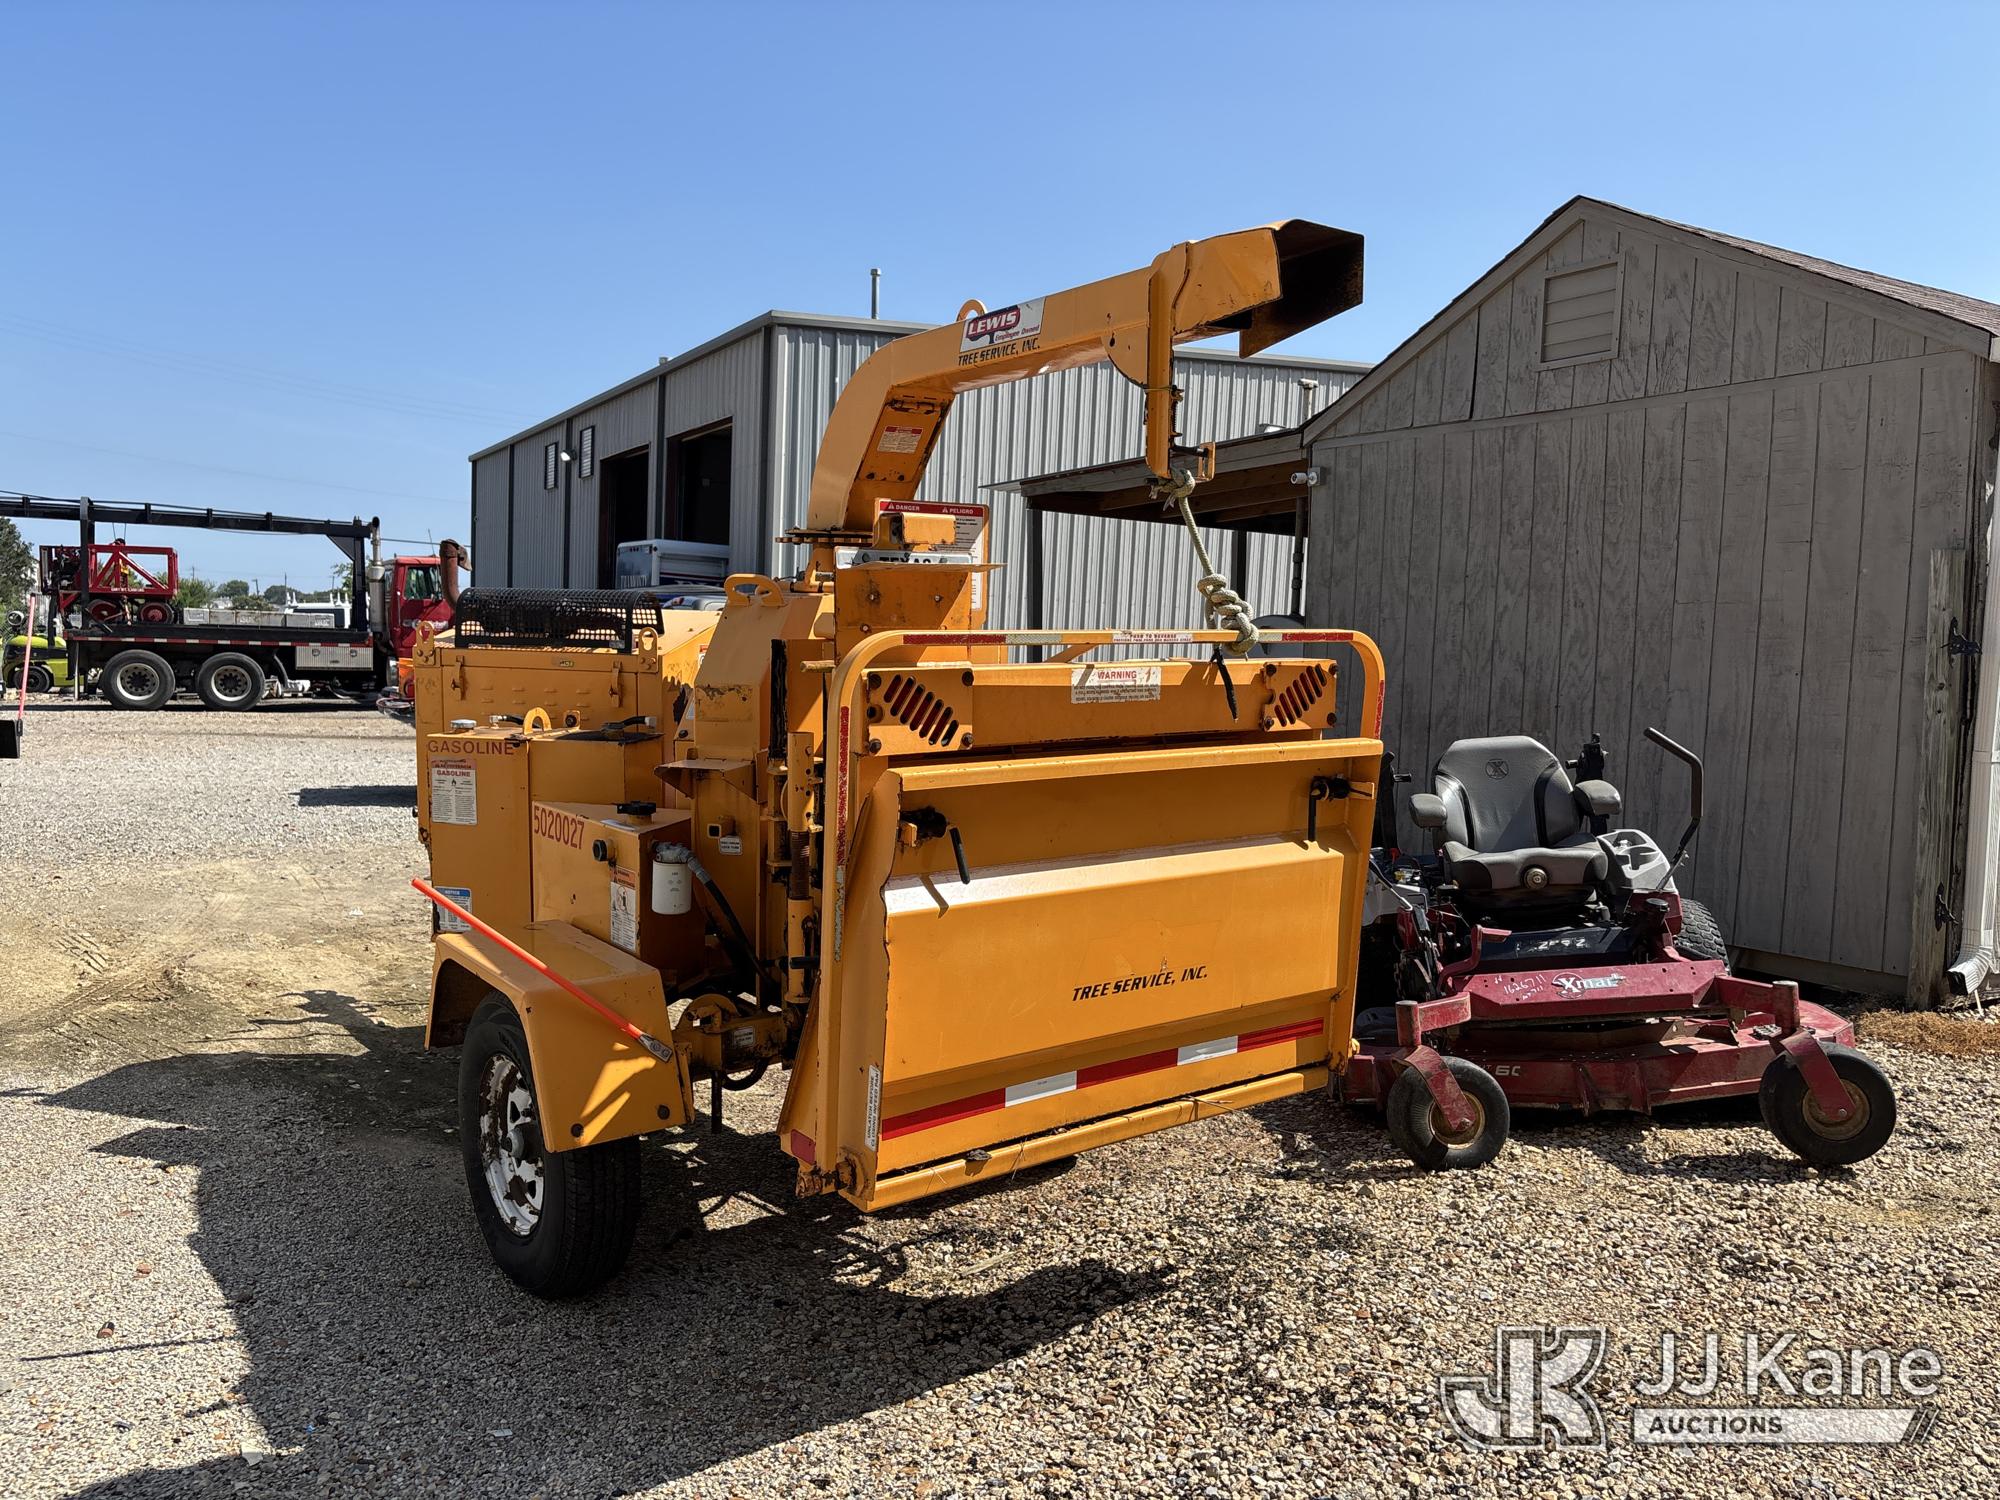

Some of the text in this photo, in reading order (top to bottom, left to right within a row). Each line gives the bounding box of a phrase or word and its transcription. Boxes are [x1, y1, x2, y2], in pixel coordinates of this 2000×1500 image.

[967, 310, 1017, 335] LEWIS
[958, 337, 1040, 366] TREE SERVICE, INC.
[1097, 670, 1137, 680] WARNING
[427, 740, 514, 756] GASOLINE
[534, 805, 585, 850] 5020027
[1072, 965, 1207, 1001] TREE SERVICE, INC.
